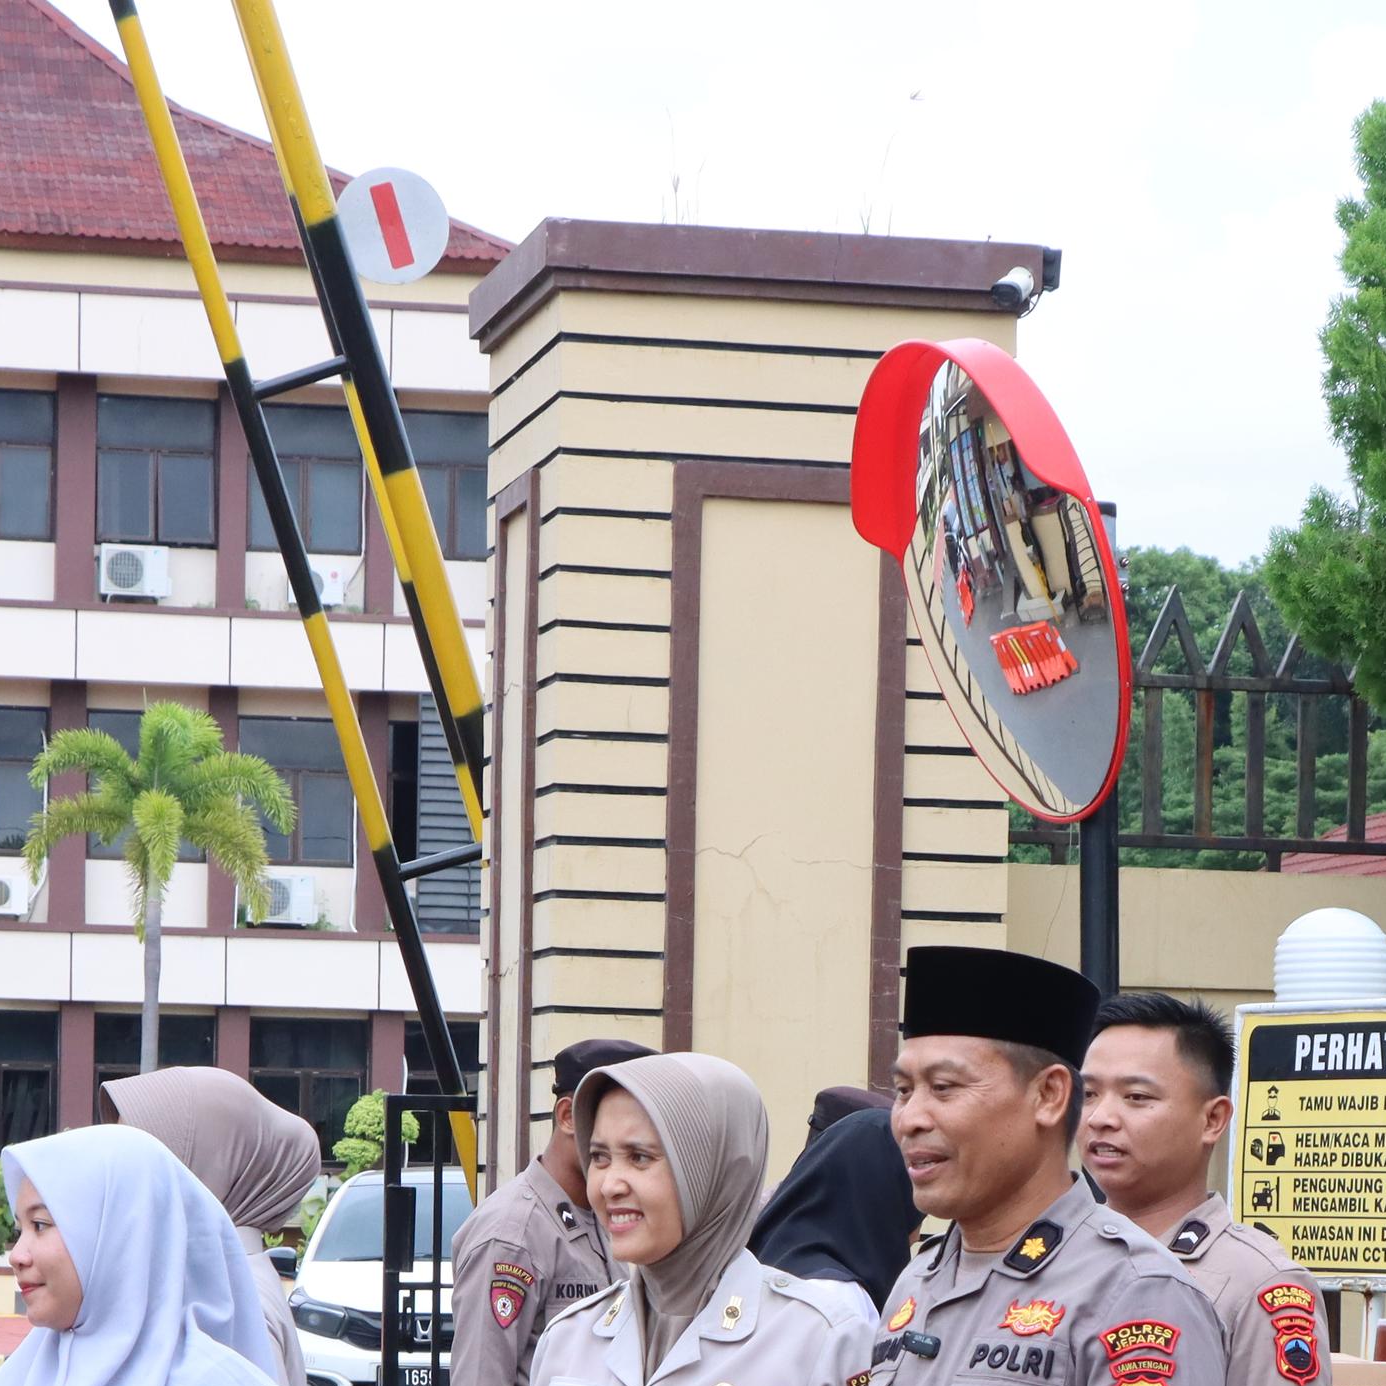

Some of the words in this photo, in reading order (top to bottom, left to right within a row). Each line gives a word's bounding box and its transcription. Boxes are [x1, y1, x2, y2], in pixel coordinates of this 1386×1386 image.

[1299, 1095, 1333, 1111] TAMU
[1337, 1095, 1379, 1111] WAJIB
[1295, 1132, 1370, 1148] HELM/KACA
[1294, 1152, 1338, 1167] HARAP
[1293, 1178, 1383, 1194] PENGUNJUNG
[1292, 1197, 1369, 1213] MENGAMBIL
[1292, 1225, 1354, 1241] KAWASAN
[1358, 1227, 1376, 1242] INI
[1291, 1246, 1358, 1262] PANTAUAN
[1106, 1324, 1173, 1345] POLRES
[1115, 1334, 1166, 1351] JEPARA
[969, 1342, 1056, 1380] POLRI
[1116, 1361, 1138, 1374] JAWA
[1137, 1361, 1169, 1373] TENGAH
